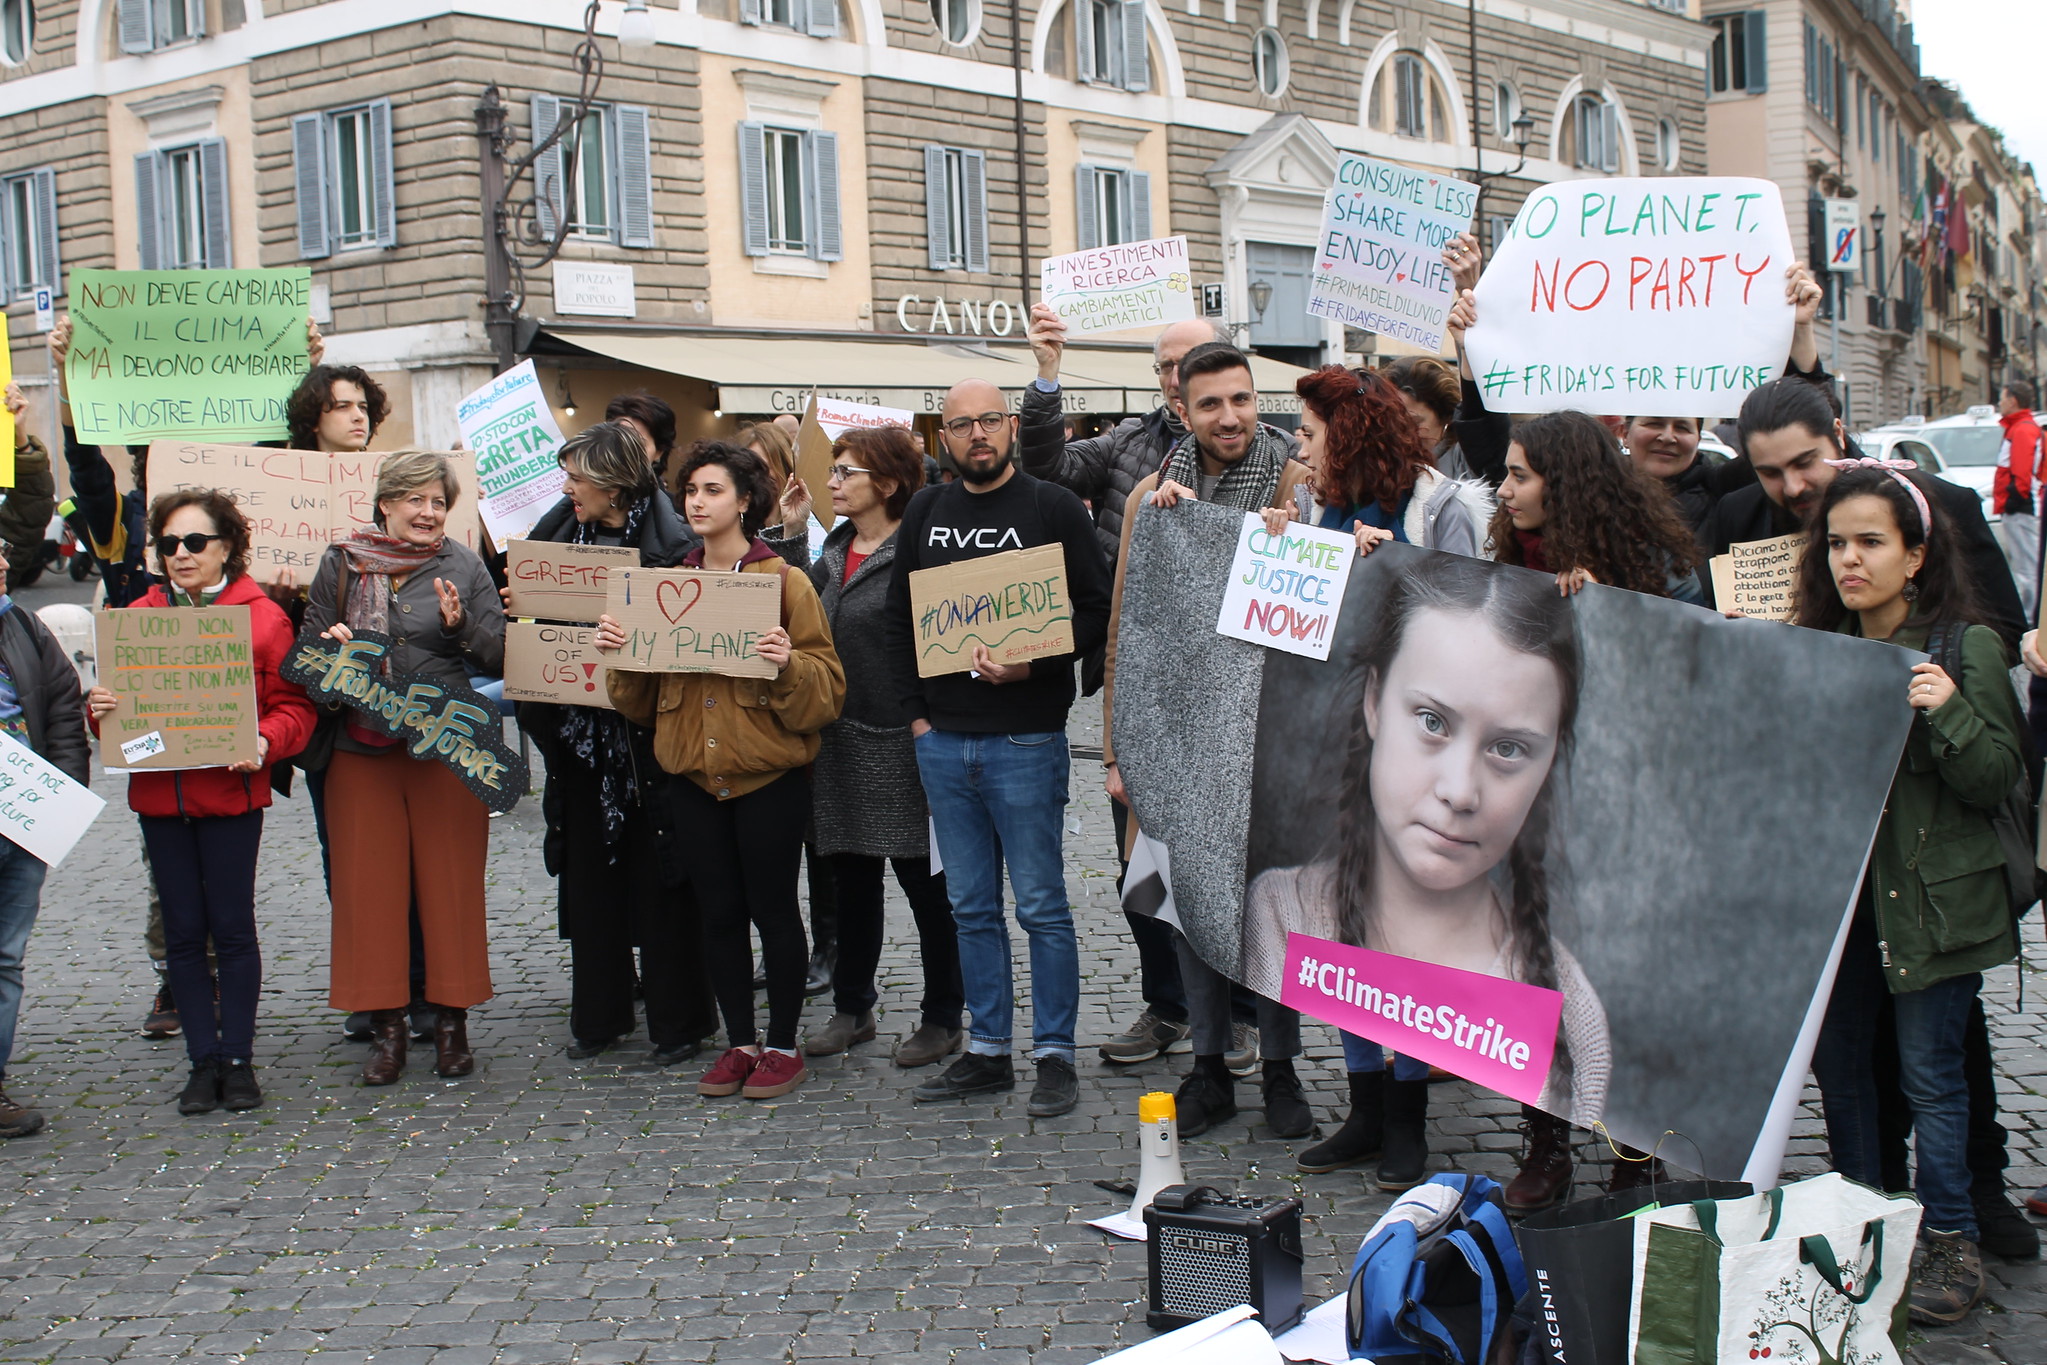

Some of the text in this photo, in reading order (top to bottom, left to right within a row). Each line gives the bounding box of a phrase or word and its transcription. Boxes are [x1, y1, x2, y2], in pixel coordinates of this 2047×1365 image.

[1339, 159, 1475, 219] CONSUME LESS
[1334, 194, 1407, 237] SHARE
[1580, 193, 1763, 237] PLANET,
[1061, 240, 1183, 274] INVESTIMENTI
[1325, 231, 1450, 293] ENJOY LIFE
[82, 278, 311, 308] NON DEVE CAMBIARE
[576, 273, 613, 285] PIAZZA
[1072, 265, 1157, 290] RICERCA
[1531, 253, 1771, 313] NO PARTY
[576, 293, 617, 305] POPOLO
[1059, 289, 1164, 317] CAMBIAMENTI
[1315, 273, 1443, 326] #PRIMADELDILUVIO
[135, 316, 264, 342] IL CLIMA
[1081, 307, 1163, 330] CLIMATICI
[1310, 296, 1440, 350] #FRIDAYSFORFUTURE
[72, 347, 309, 380] MA DEVONO CAMBIARE
[1483, 359, 1615, 398] #FRIDAYS
[1625, 366, 1667, 391] FOR
[79, 402, 111, 433] LE
[118, 399, 195, 429] NOSTRE
[179, 447, 216, 465] SE
[475, 425, 554, 477] GRETA
[481, 450, 558, 493] THUNBERG
[291, 497, 329, 511] UNA
[1248, 528, 1344, 571] CLIMATE
[1732, 543, 1777, 558] Diciamo
[1780, 539, 1790, 550] di
[1242, 560, 1331, 606] JUSTICE
[1734, 569, 1774, 580] Diciamo
[1778, 567, 1787, 576] di
[920, 575, 1064, 641] #ONDAVERDE
[1243, 599, 1330, 649] NOW!!
[198, 618, 233, 635] NON
[539, 628, 592, 645] ONE
[669, 626, 766, 660] PLANE
[555, 649, 582, 662] OF
[152, 672, 182, 690] CHE
[188, 671, 220, 690] NON
[224, 666, 251, 688] AMA
[197, 702, 214, 712] SU
[218, 702, 238, 712] UNA
[120, 719, 149, 731] VERA
[7, 752, 66, 794] are not
[17, 788, 45, 802] for
[1298, 955, 1531, 1071] #ClimateStrike
